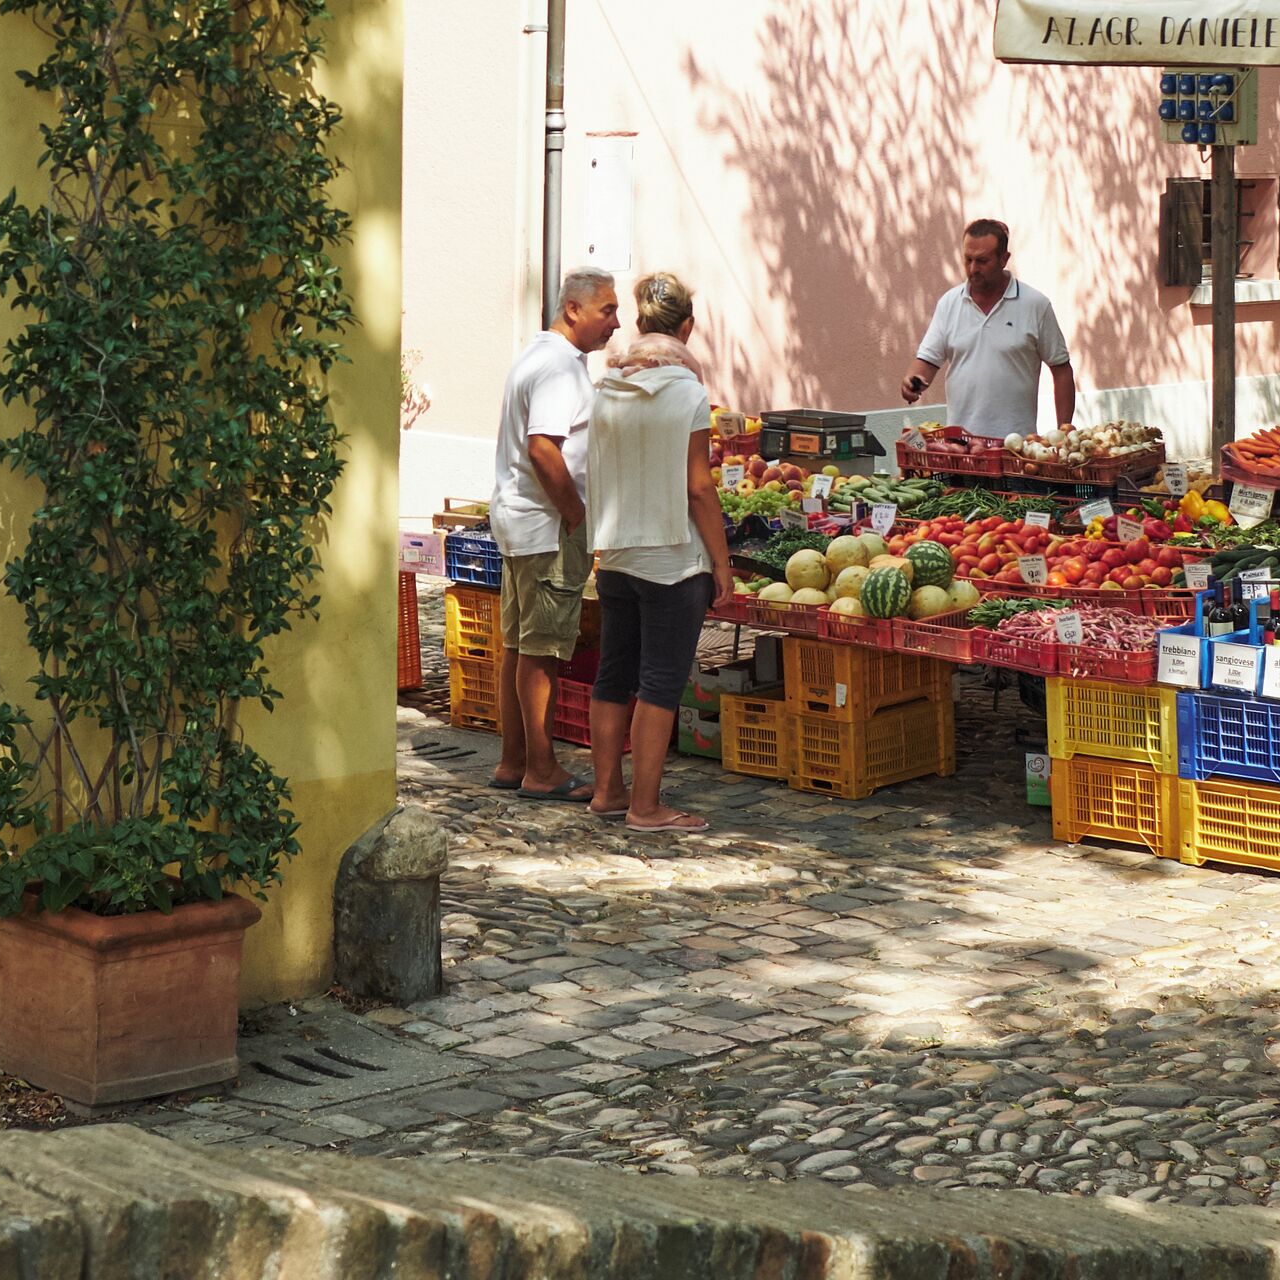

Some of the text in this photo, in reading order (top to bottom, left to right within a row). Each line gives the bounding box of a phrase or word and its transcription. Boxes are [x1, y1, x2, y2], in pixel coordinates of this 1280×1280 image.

[1159, 16, 1279, 48] DANIELE
[1162, 645, 1197, 656] trebbiano
[1215, 655, 1255, 667] sangiovese
